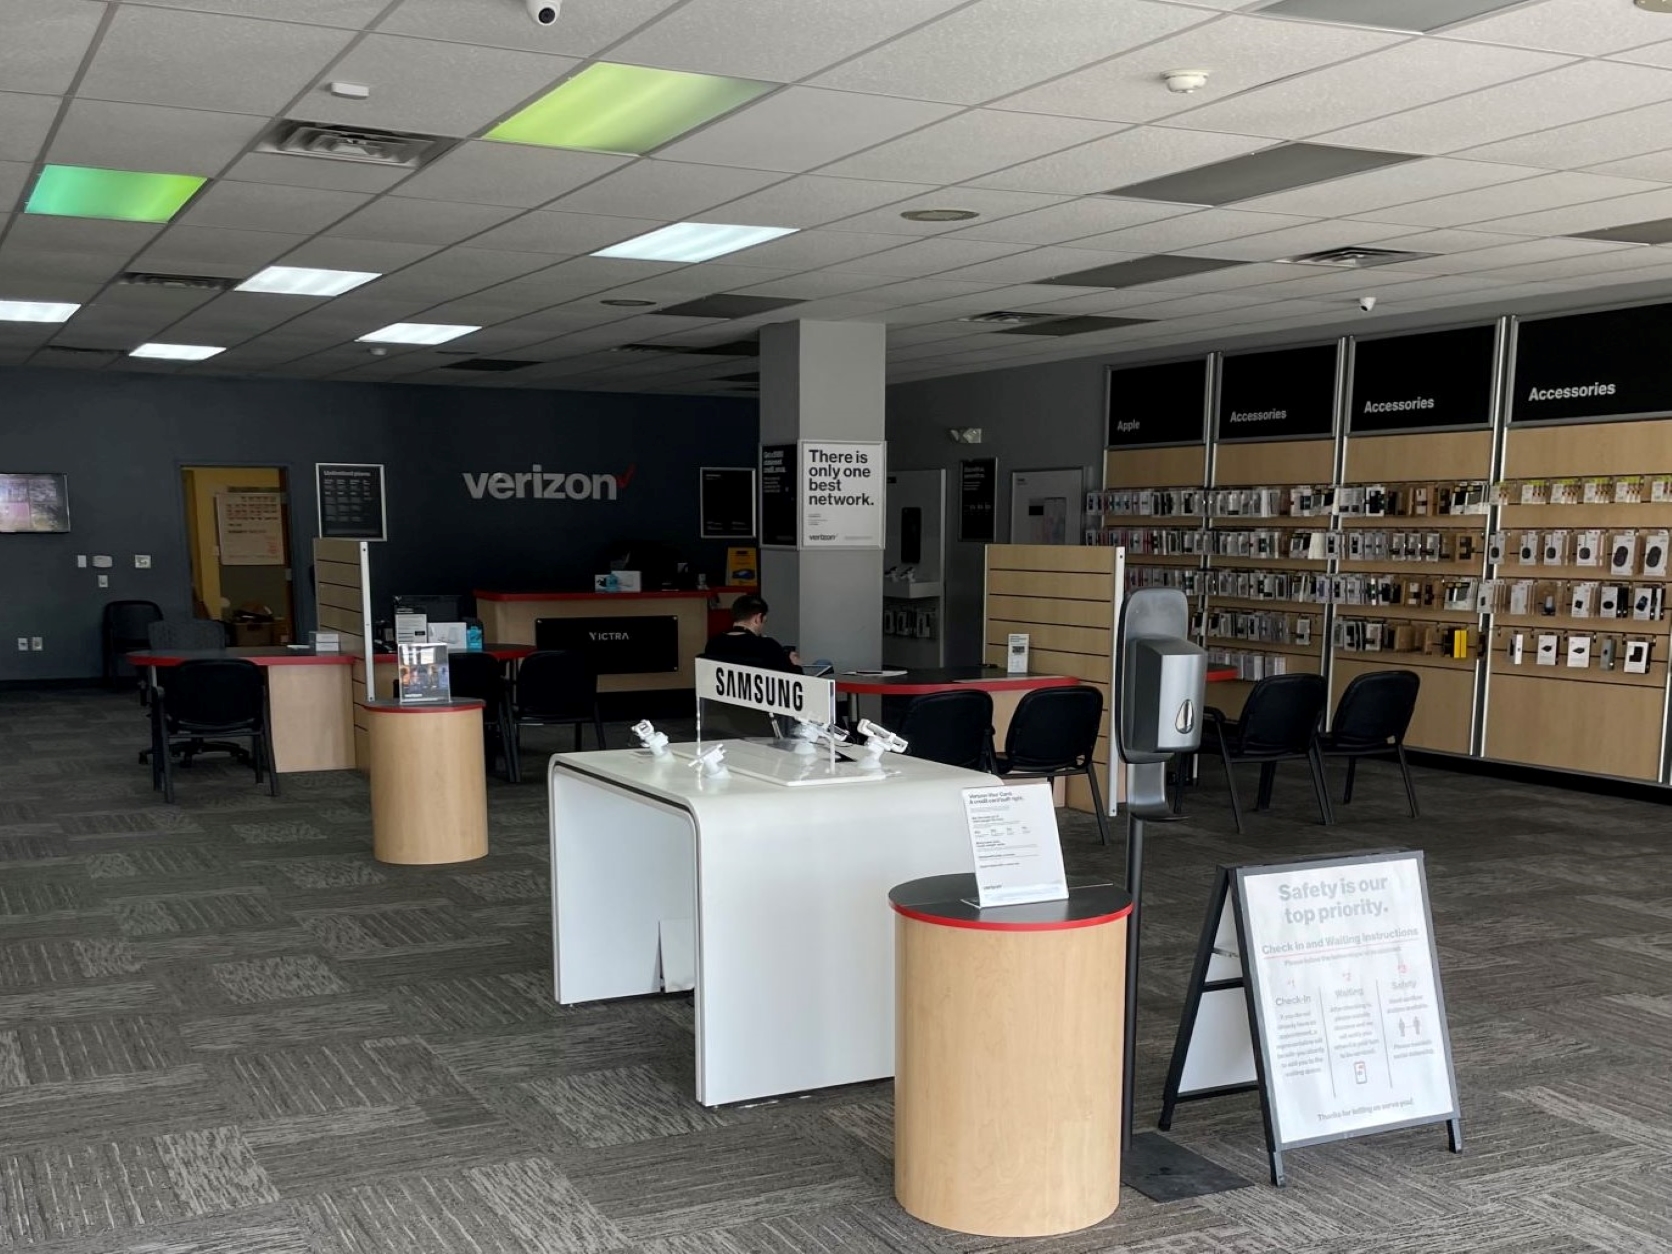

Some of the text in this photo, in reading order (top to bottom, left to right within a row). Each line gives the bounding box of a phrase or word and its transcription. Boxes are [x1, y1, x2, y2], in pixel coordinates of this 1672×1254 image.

[1528, 382, 1616, 402] Accessories
[1364, 396, 1435, 413] Accessories
[1230, 408, 1287, 423] Accessories
[1117, 419, 1140, 432] Apple
[808, 449, 868, 464] There is
[808, 464, 871, 480] only one
[462, 464, 617, 501] verizon
[809, 478, 842, 491] best
[808, 493, 874, 506] network.
[588, 631, 630, 641] VICTRA
[715, 667, 803, 712] SAMSUNG
[1278, 876, 1388, 901] Safety is our
[1284, 899, 1389, 925] top priority.
[1261, 942, 1293, 955] Check
[1306, 938, 1324, 950] and
[1325, 934, 1361, 948] Waiting
[1334, 987, 1364, 998] Waiting
[1391, 980, 1417, 990] Safety
